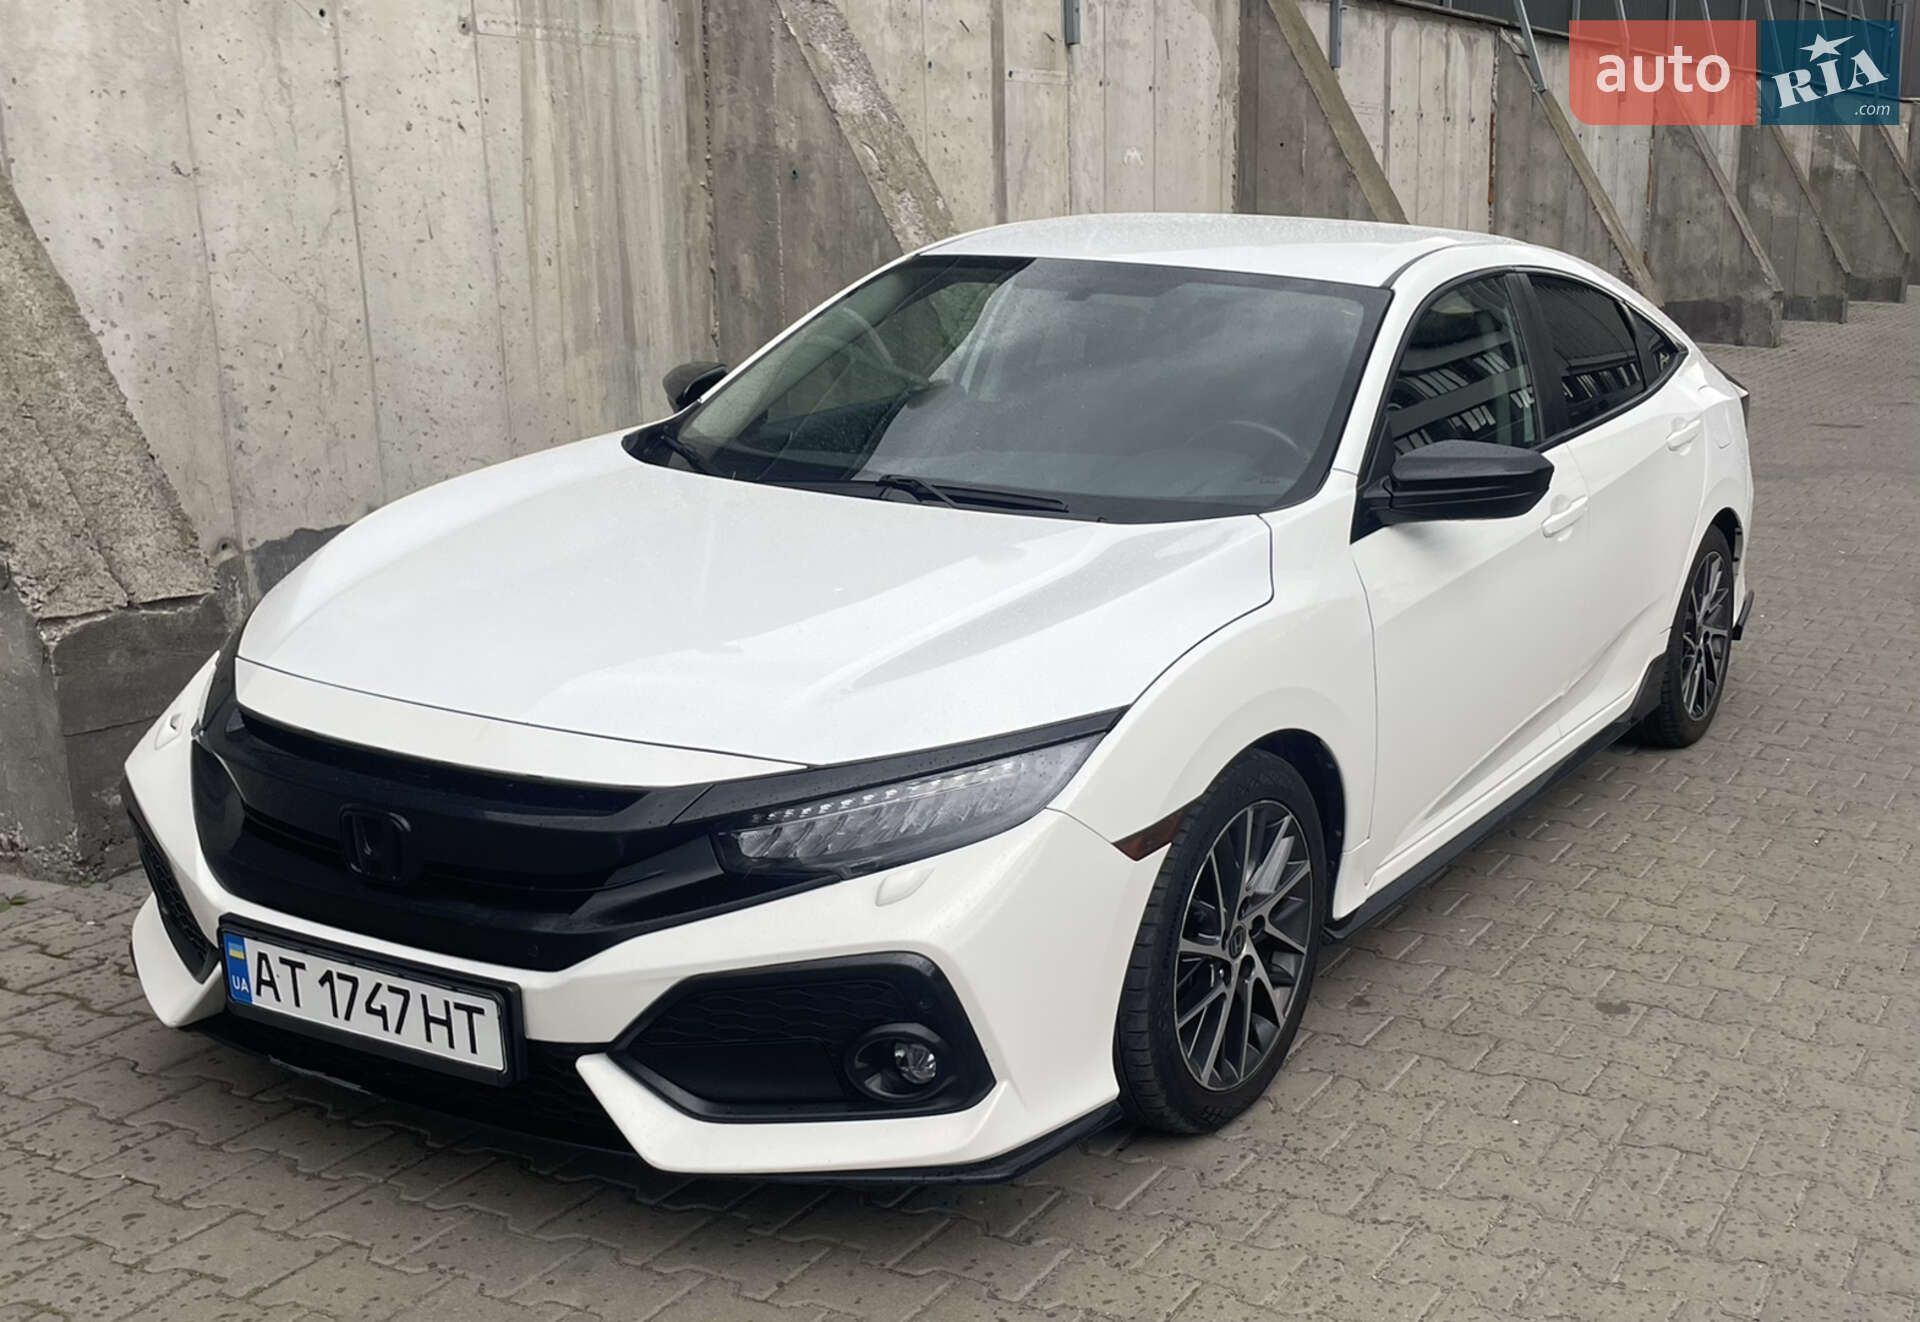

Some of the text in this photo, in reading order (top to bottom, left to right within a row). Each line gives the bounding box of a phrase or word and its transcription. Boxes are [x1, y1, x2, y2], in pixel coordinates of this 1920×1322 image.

[231, 974, 250, 993] UA
[255, 951, 486, 1055] AT 1747 HT
